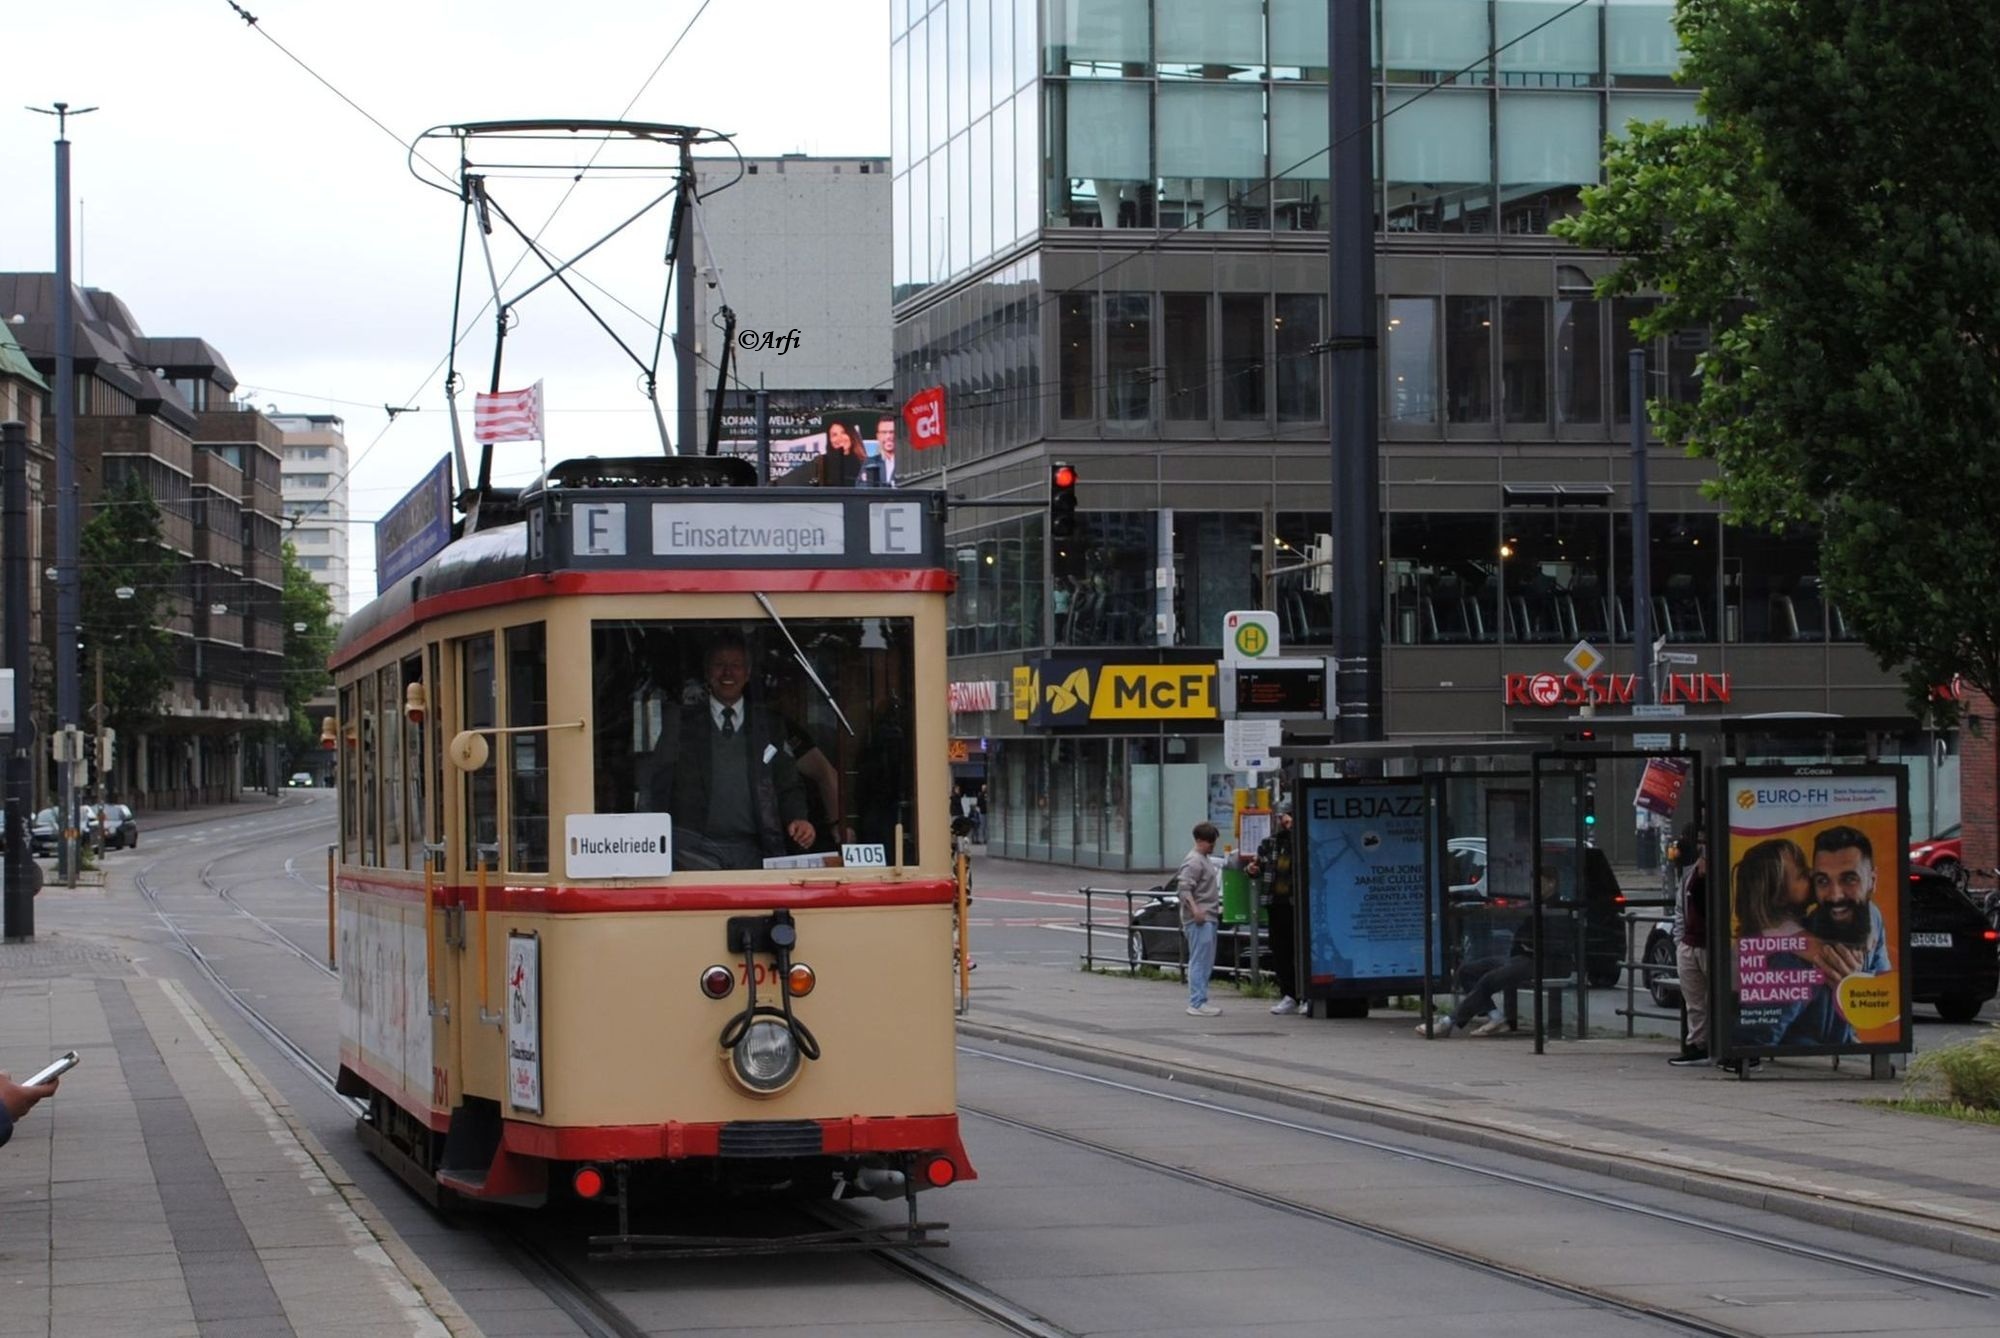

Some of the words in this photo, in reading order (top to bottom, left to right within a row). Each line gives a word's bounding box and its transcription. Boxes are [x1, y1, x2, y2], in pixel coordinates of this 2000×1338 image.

[671, 521, 825, 553] Einsatzwagen
[885, 508, 906, 552] E
[1244, 629, 1259, 650] H
[1113, 674, 1218, 709] McFI
[1505, 672, 1732, 707] ROSSMNN
[1757, 789, 1828, 803] EURO-FH
[580, 836, 656, 854] Huckelriede
[844, 846, 884, 864] 4105
[1388, 874, 1424, 884] CULLU
[1740, 937, 1807, 951] STUDIERE
[1740, 955, 1765, 968] MIT
[1740, 970, 1823, 985] WORK-LIFE-
[1740, 987, 1809, 1002] BALANCE
